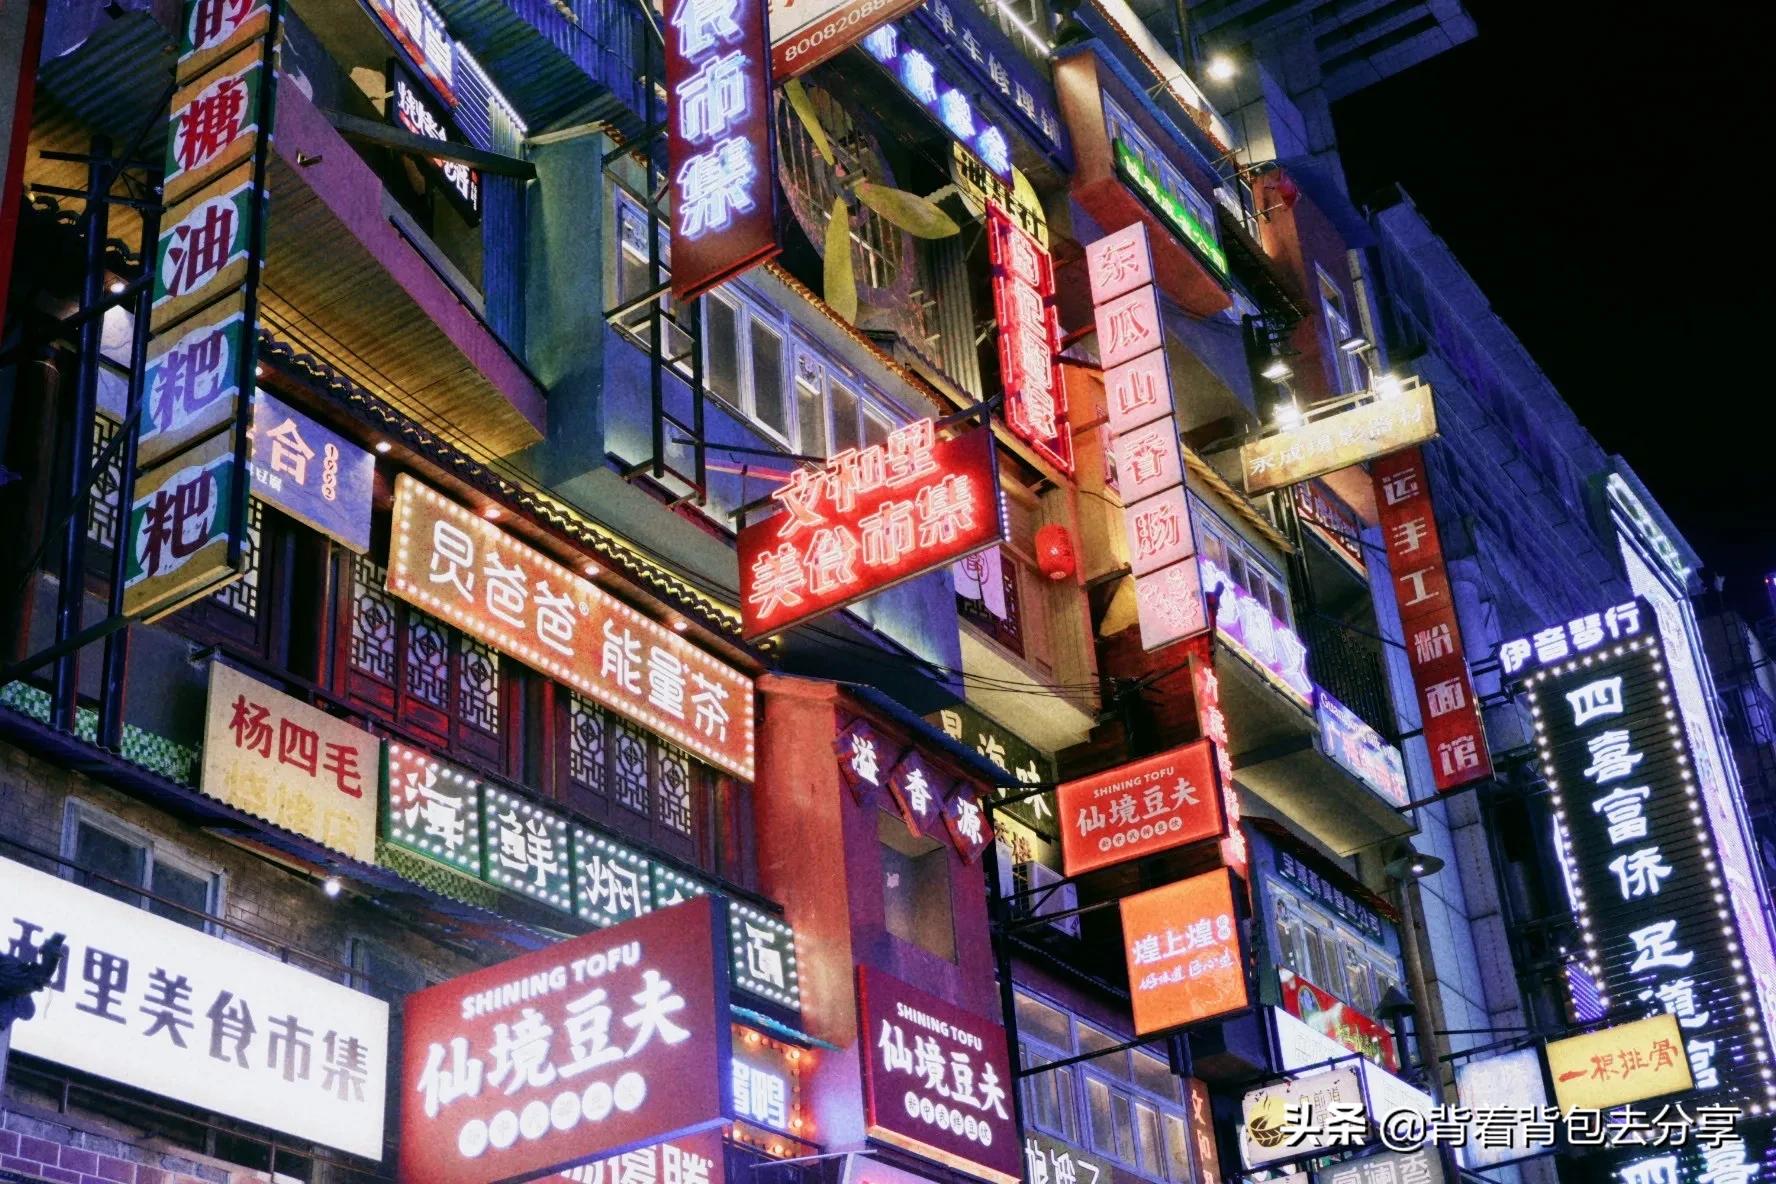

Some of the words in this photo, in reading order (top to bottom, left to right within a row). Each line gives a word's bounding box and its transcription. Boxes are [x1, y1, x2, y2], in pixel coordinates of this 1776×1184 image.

[786, 0, 891, 61] 80082088
[772, 417, 938, 538] 文和里
[748, 473, 974, 621] 美食市集
[1499, 601, 1641, 675] 伊音琴行
[229, 694, 363, 799] 杨四毛
[1094, 775, 1142, 799] SHINING
[1144, 766, 1174, 782] TOFU
[1076, 777, 1200, 837] 仙境豆夫
[405, 767, 785, 988] 海鲜焖面
[461, 965, 568, 1019] SHINING
[571, 940, 641, 982] TOFU
[1132, 917, 1216, 966] 煌上煌
[416, 969, 691, 1118] 仙境豆夫
[896, 1001, 949, 1036] SHINING
[949, 1025, 983, 1052] TOFU
[1559, 1038, 1679, 1083] 一根排骨
[878, 1018, 1010, 1120] 仙境豆夫
